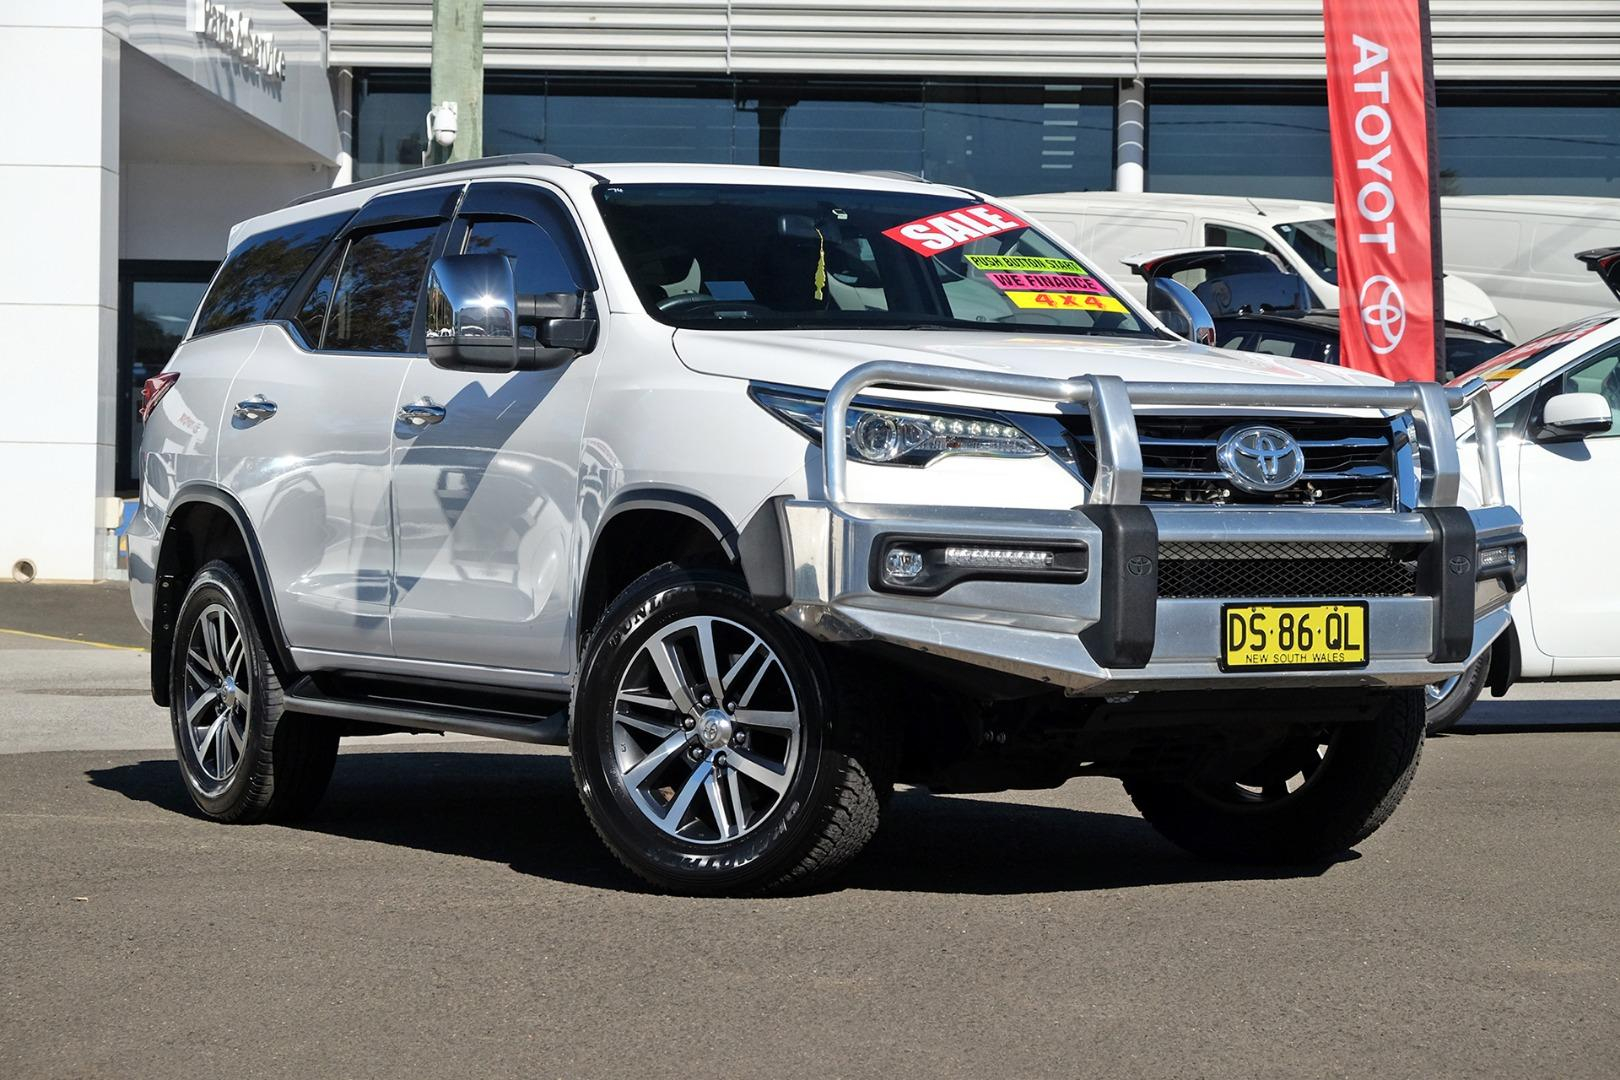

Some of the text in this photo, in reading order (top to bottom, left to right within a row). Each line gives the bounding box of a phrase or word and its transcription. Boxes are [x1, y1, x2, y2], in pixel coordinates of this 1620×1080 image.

[900, 207, 1018, 250] SALE
[971, 256, 1081, 270] PUSH BUTTON START
[994, 274, 1097, 290] WE FINANCE
[1245, 652, 1345, 664] NEW SOUTH WALES
